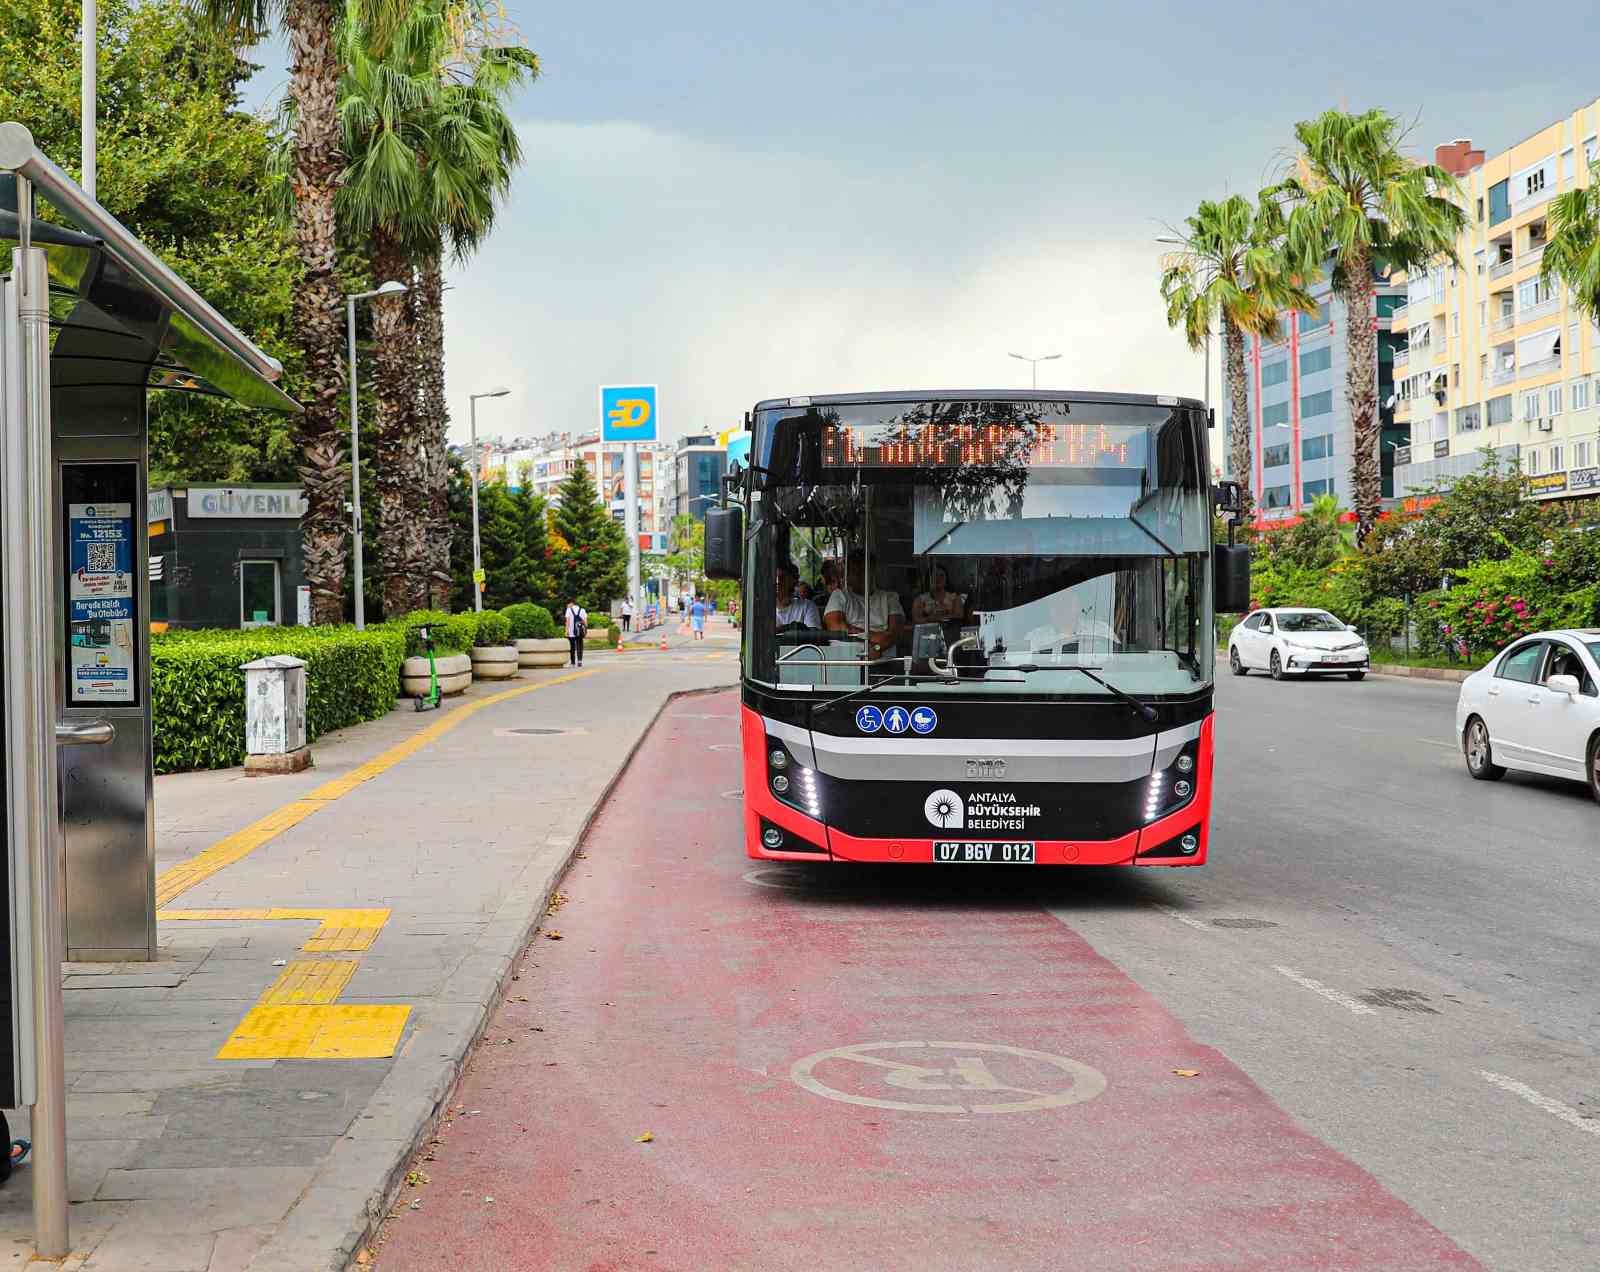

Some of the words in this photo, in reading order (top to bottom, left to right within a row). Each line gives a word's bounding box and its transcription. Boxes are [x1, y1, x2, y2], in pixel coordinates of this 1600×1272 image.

[968, 793, 1017, 803] ANTALYA
[967, 817, 1025, 830] BELEDİYESİ
[940, 843, 959, 861] 07
[965, 843, 993, 861] BGV
[1002, 844, 1031, 861] 012
